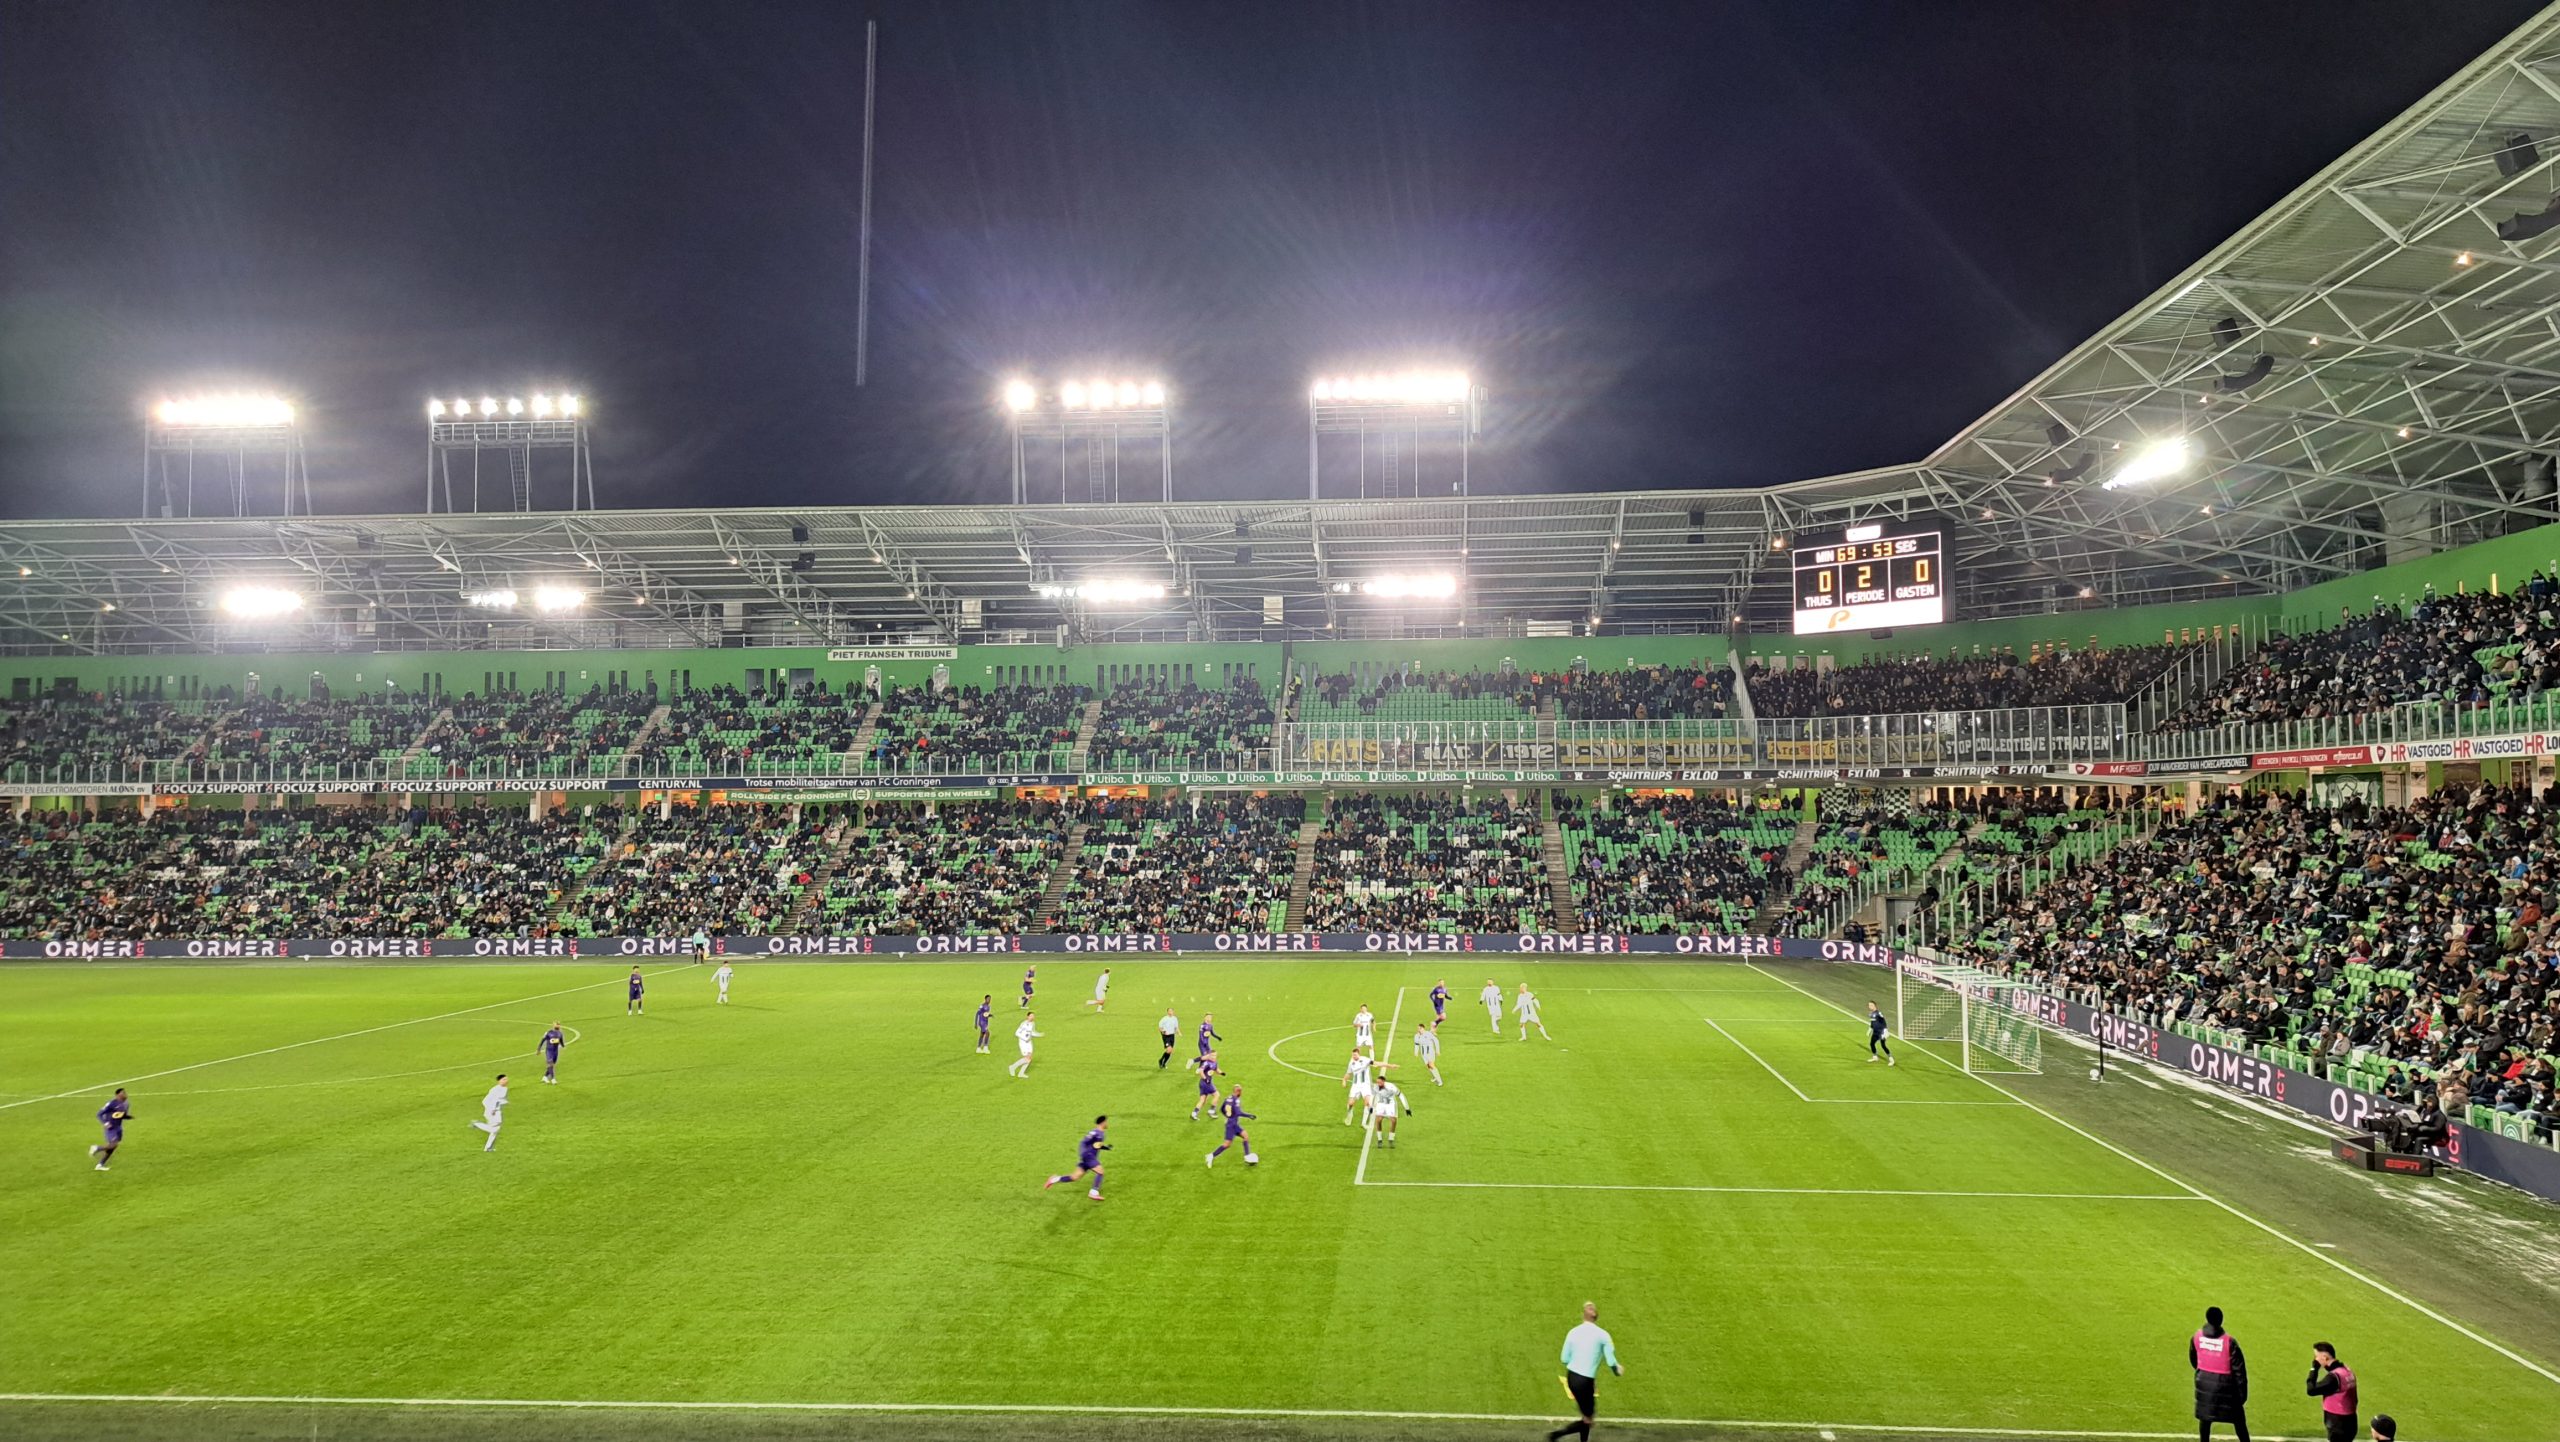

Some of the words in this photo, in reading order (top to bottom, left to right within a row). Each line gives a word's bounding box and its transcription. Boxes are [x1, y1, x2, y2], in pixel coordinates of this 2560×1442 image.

[1816, 550, 1835, 563] MIN
[1837, 546, 1856, 562] 69
[1873, 542, 1892, 557] 53
[1895, 540, 1917, 554] SEC
[1857, 565, 1871, 588] 2
[1915, 559, 1929, 582] 0
[1818, 570, 1832, 593] 0
[1846, 588, 1885, 604] PERIODE
[1896, 584, 1935, 598] GASTEN
[1804, 595, 1832, 608] THUIS
[833, 651, 855, 659] PIET
[858, 650, 904, 659] FRANSEN
[908, 650, 952, 658] TRIBUNE
[1504, 744, 1554, 759] 1912
[1946, 739, 1972, 755] STOP
[2391, 744, 2406, 761] HR
[2407, 744, 2452, 758] VASTGOED
[2454, 740, 2471, 758] HR
[2472, 739, 2523, 754] VASTGOED
[2525, 734, 2545, 754] HR
[1430, 772, 1457, 780] Utibo.
[1478, 772, 1508, 780] Utibo.
[1527, 772, 1557, 780] Utibo.
[1607, 771, 1672, 781] SCHUTRUPS
[1682, 771, 1719, 780] EXLOO
[1777, 770, 1839, 779] SCHUTRUPS
[1933, 767, 1999, 777] SCHUTRUPS
[2110, 765, 2124, 773] MF
[638, 780, 702, 788] CENTURY.NL
[775, 778, 857, 788] mobiliteitspartner
[892, 777, 941, 787] Groningen
[1097, 776, 1126, 784] Utibo.
[1144, 775, 1173, 783] Utibo.
[1191, 774, 1220, 782] Utibo.
[1239, 774, 1268, 782] Utibo.
[1286, 773, 1316, 782] Utibo.
[1334, 773, 1363, 781] Utibo.
[1380, 773, 1410, 781] Utibo.
[37, 785, 108, 793] ELEKTROMOTOREN
[163, 784, 204, 794] FOCUZ
[207, 784, 263, 793] SUPPORT
[274, 783, 315, 792] FOCUZ
[318, 783, 375, 792] SUPPORT
[390, 783, 433, 792] FOCUZ
[435, 782, 493, 792] SUPPORT
[504, 782, 546, 790] FOCUZ
[550, 781, 608, 790] SUPPORT
[45, 941, 132, 956] ORMER
[187, 940, 274, 956] ORMER
[330, 939, 418, 956] ORMER
[475, 939, 564, 955] ORMER
[769, 937, 858, 953] ORMER
[916, 936, 1007, 952] ORMER
[1065, 935, 1156, 951] ORMER
[1215, 934, 1306, 950] ORMER
[1366, 934, 1458, 951] ORMER
[1519, 934, 1615, 951] ORMER
[1676, 936, 1769, 953] ORMER
[2012, 987, 2059, 1023] ORMER
[2090, 1012, 2148, 1054] ORMER
[2190, 1043, 2272, 1097] ORMER
[2448, 1124, 2460, 1164] ICT
